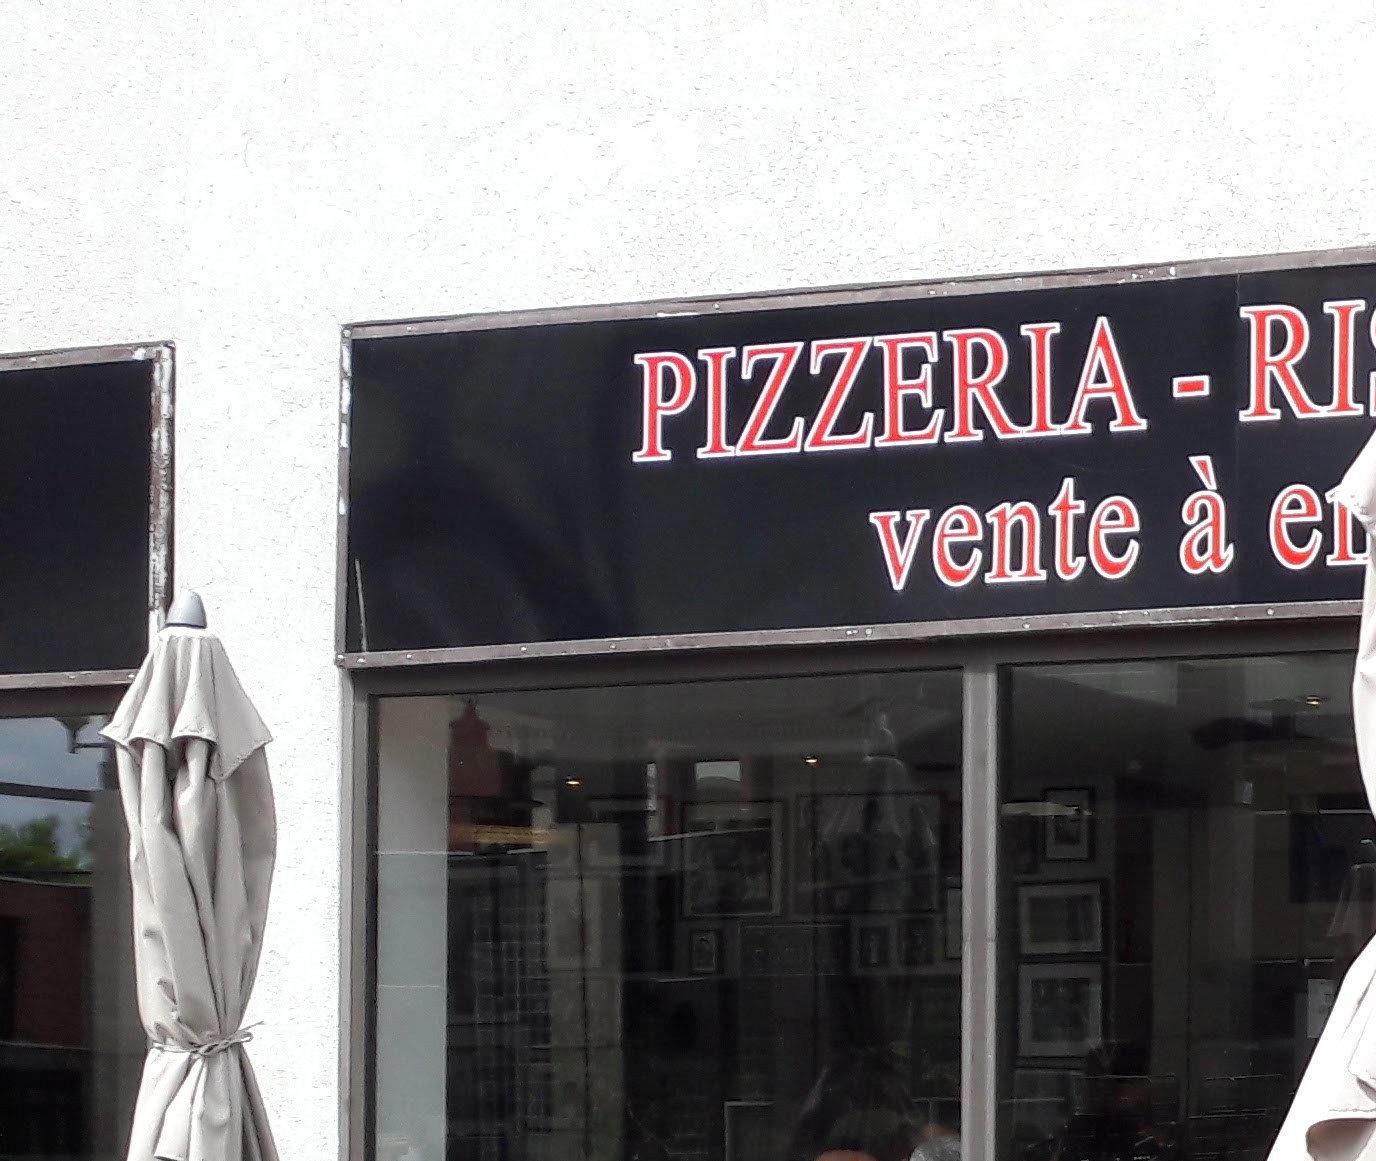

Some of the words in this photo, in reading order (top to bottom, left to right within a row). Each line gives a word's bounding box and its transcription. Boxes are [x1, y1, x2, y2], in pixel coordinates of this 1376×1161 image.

[632, 316, 1147, 462] PIZZERIA
[869, 477, 1141, 591] vente
[1179, 455, 1234, 575] à
